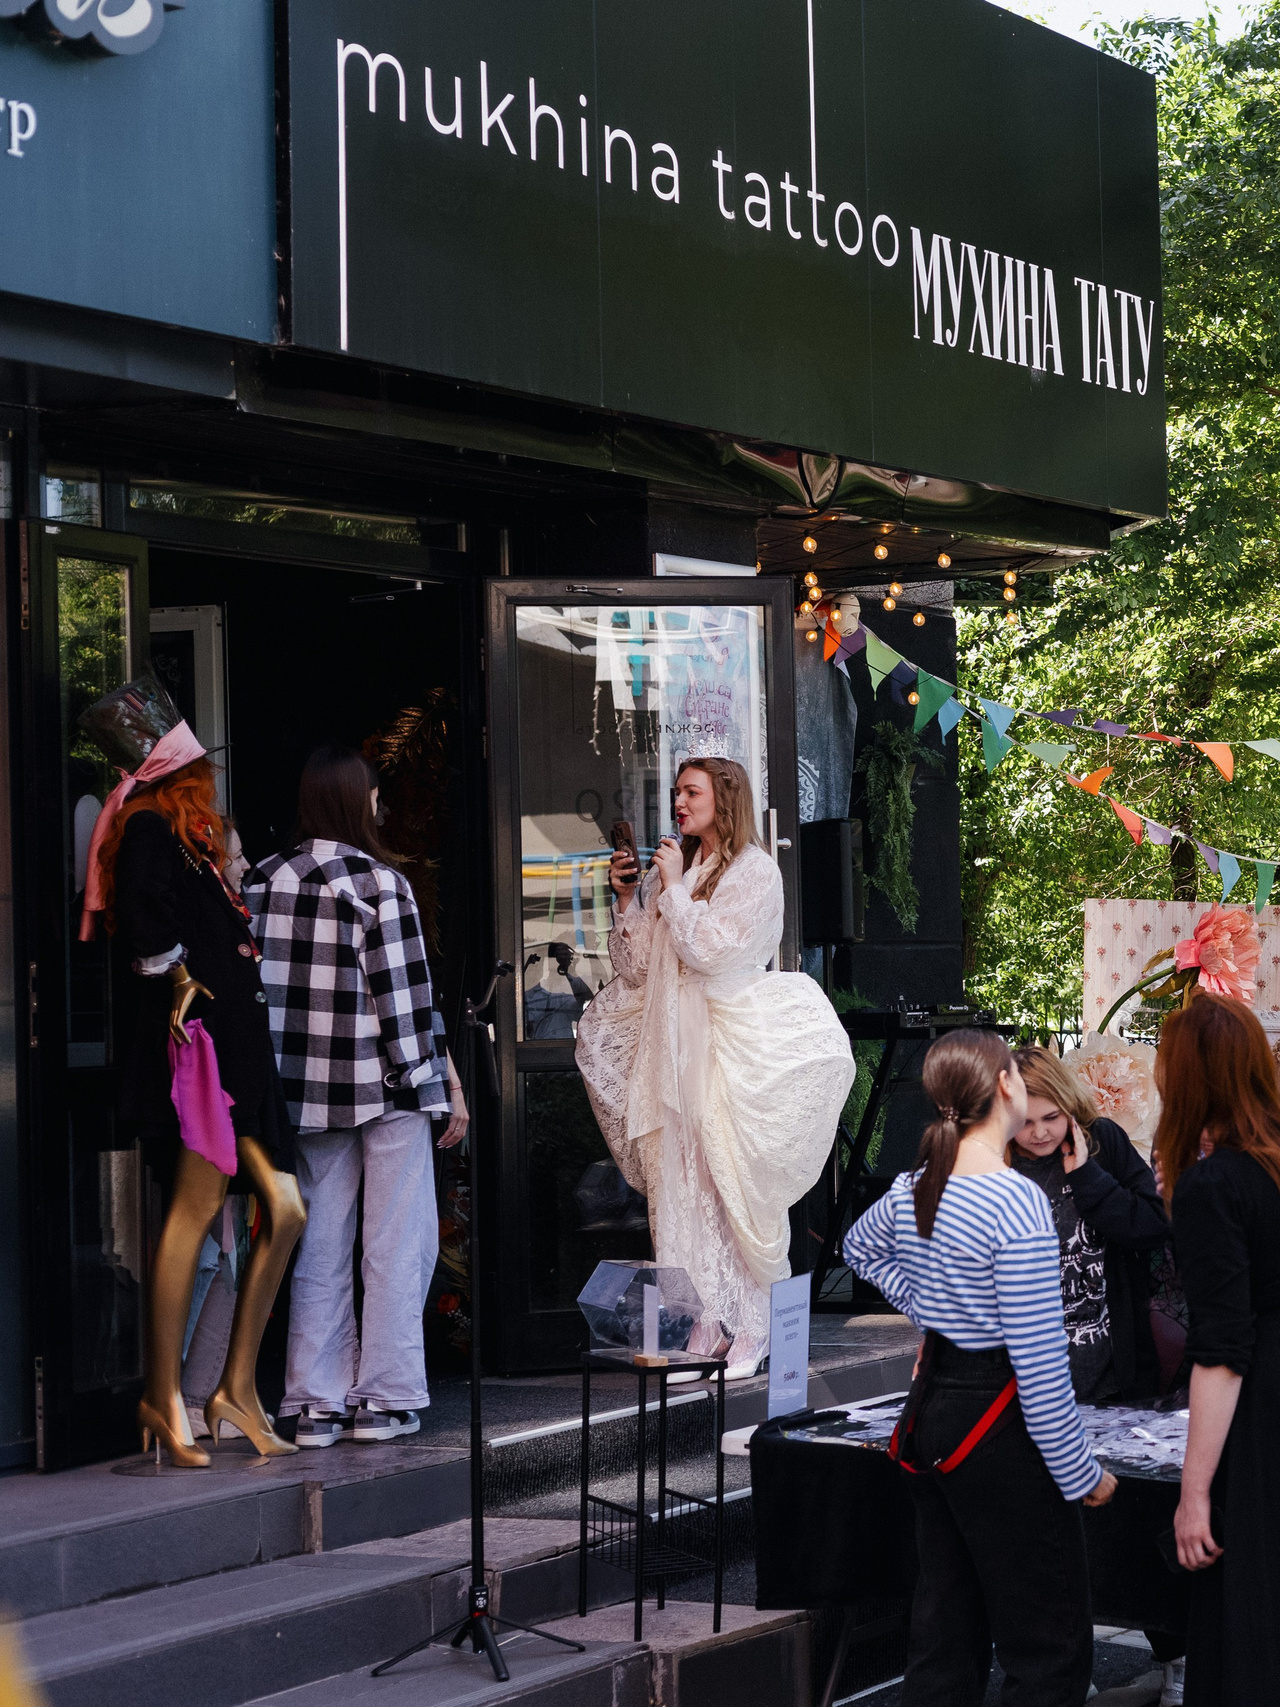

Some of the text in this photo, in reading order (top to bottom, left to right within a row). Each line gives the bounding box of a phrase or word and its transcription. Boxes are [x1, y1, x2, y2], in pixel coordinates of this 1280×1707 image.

[0, 97, 37, 157] р
[336, 0, 899, 351] mukhina tattoo
[911, 227, 1155, 395] МУХИНА ТАТУ
